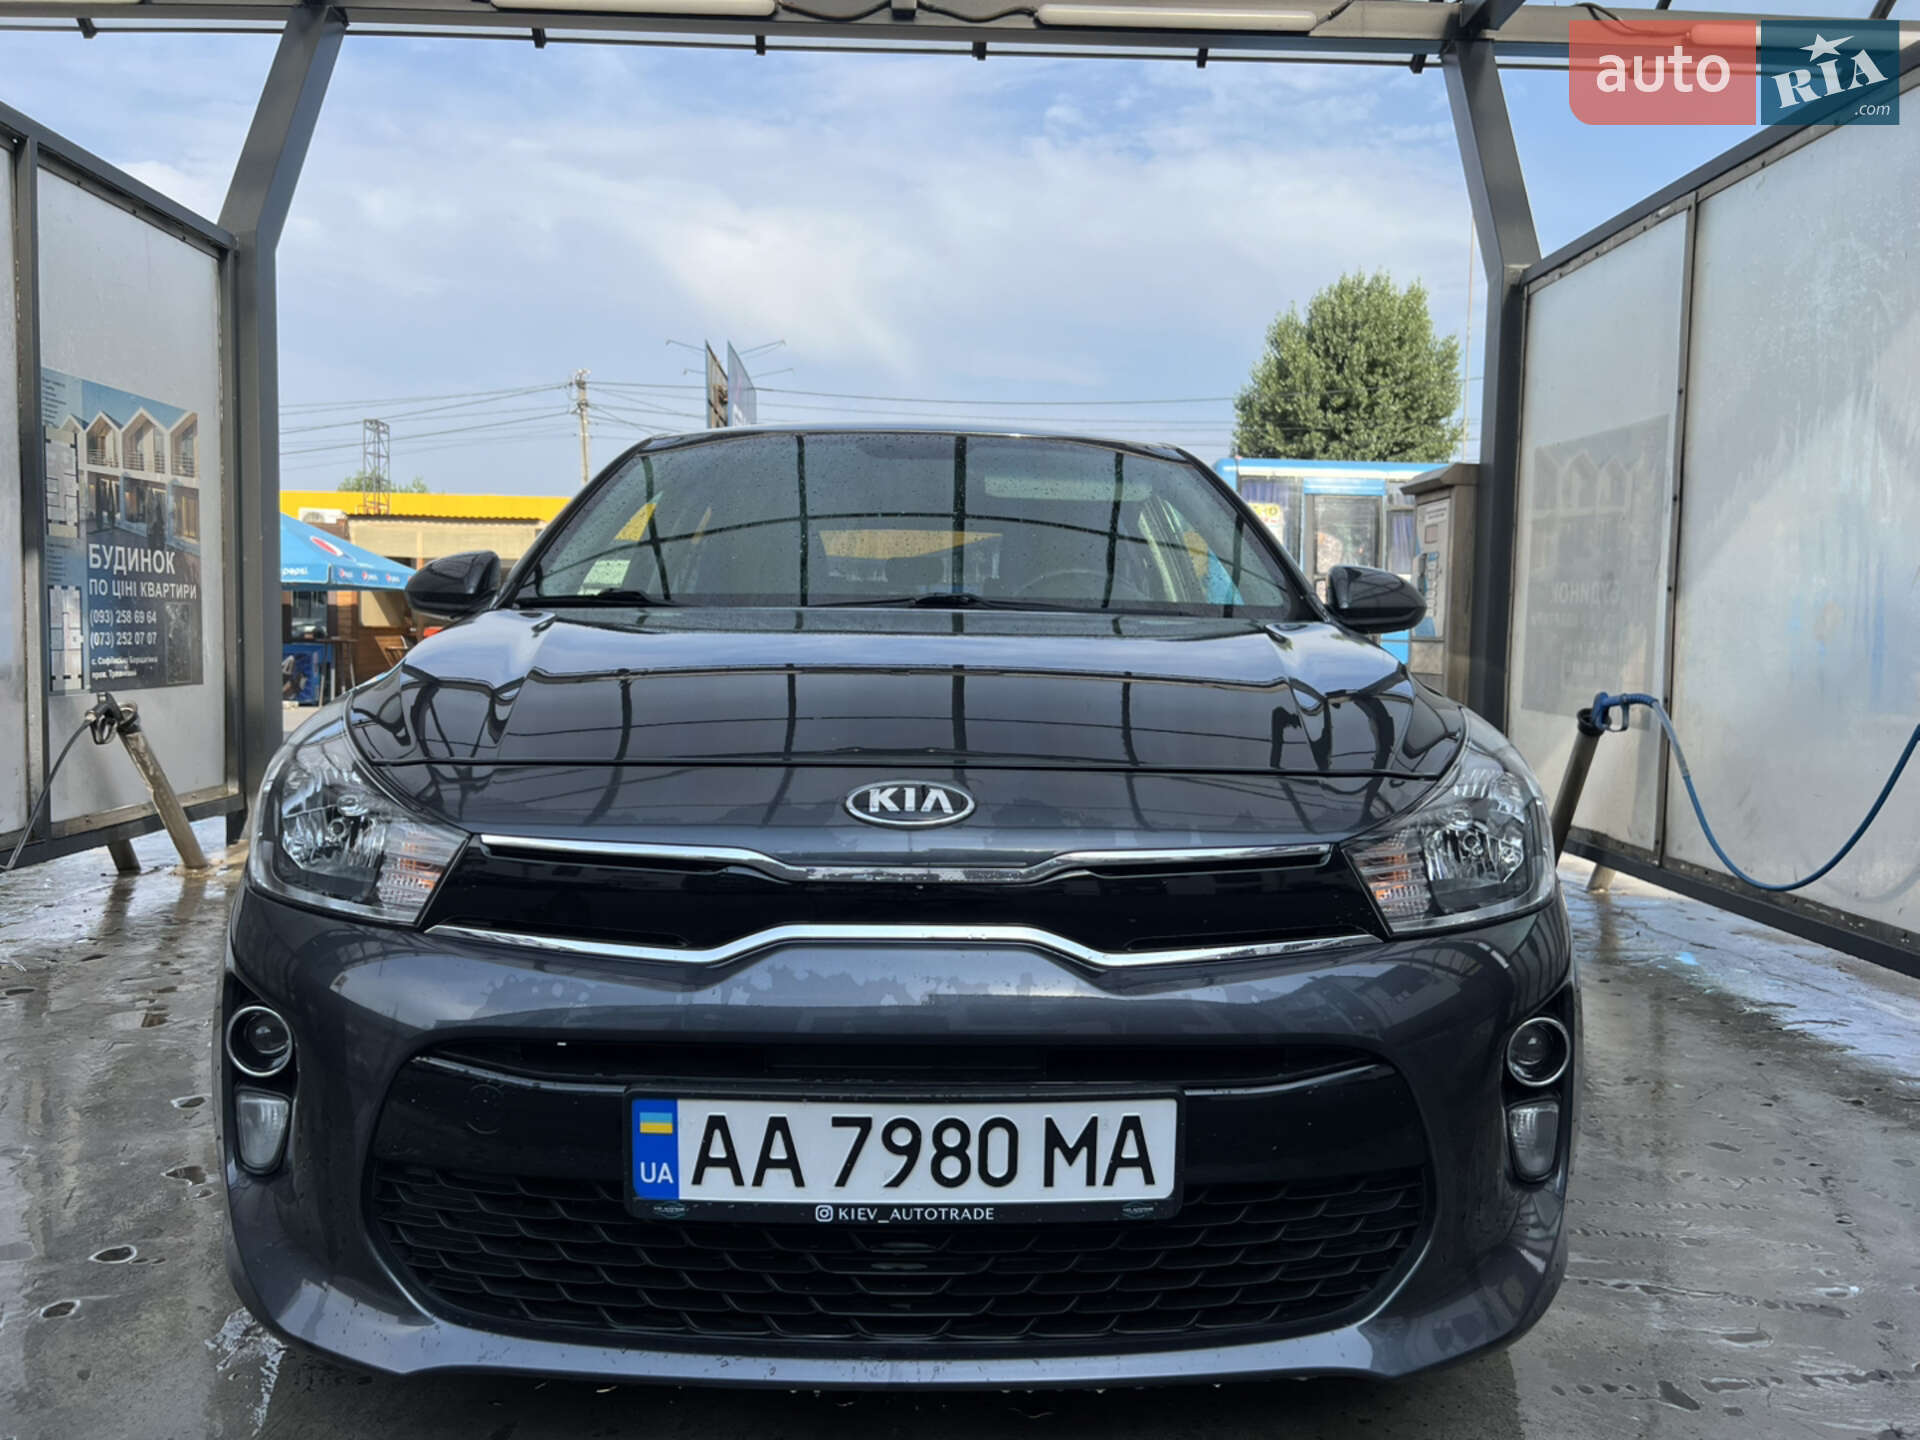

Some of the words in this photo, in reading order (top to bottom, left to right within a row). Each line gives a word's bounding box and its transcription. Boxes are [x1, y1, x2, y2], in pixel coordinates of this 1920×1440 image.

[88, 543, 176, 575] БУДИНОК
[88, 578, 108, 597] ПО
[112, 580, 137, 599] ЦІНІ
[140, 581, 197, 600] КВАРТИРИ
[90, 631, 114, 650] (073)
[115, 631, 133, 646] 252
[134, 631, 145, 646] 07
[146, 631, 157, 646] 07
[869, 787, 954, 814] KIA
[691, 1114, 806, 1188] AA
[831, 1115, 1019, 1189] 7980
[1044, 1114, 1156, 1188] MA
[640, 1162, 674, 1184] UA
[838, 1207, 995, 1224] KIEV_AUTOTRADE
